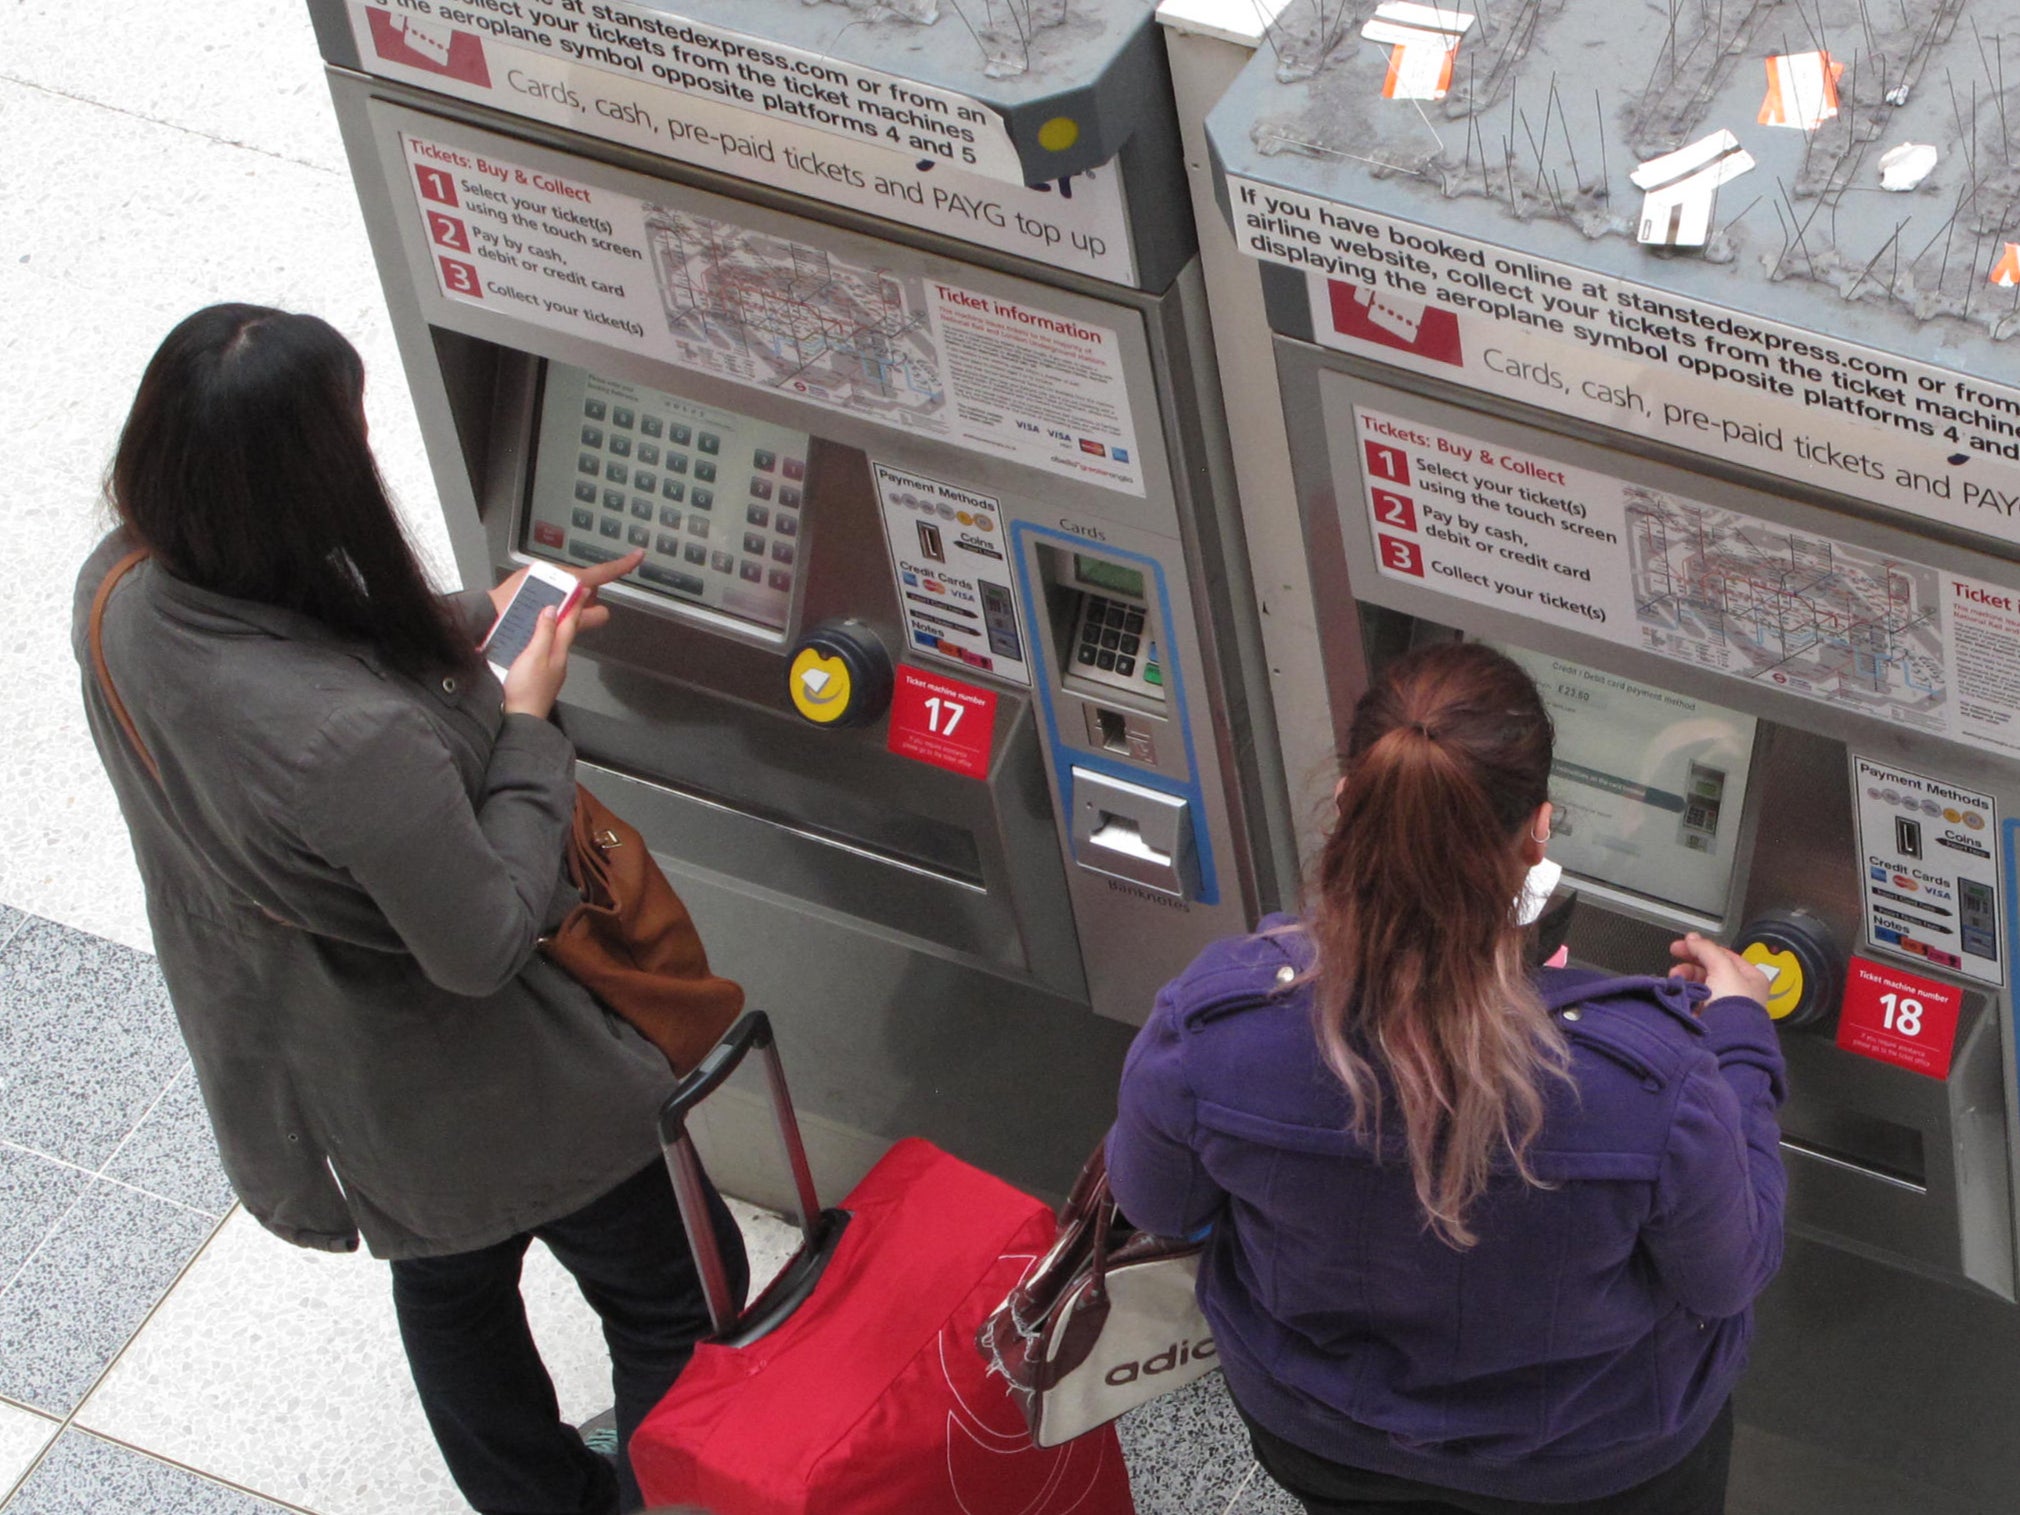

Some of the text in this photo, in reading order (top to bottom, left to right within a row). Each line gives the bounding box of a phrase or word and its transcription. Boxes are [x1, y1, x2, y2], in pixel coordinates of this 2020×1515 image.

[439, 5, 553, 47] aeroplane
[559, 38, 644, 73] symbol
[651, 63, 755, 103] opposite
[762, 93, 879, 137] platforms
[885, 125, 901, 144] 4
[908, 135, 954, 159] and
[961, 145, 977, 165] 5
[528, 9, 580, 34] your
[586, 21, 666, 58] tickets
[671, 44, 730, 76] from
[736, 62, 776, 88] the
[782, 75, 851, 109] ticket
[857, 99, 975, 143] machines
[561, 0, 987, 126] at stanstedexpress.com or from an
[408, 138, 592, 204] Tickets: Buy & Collect
[429, 173, 444, 199] 1
[507, 69, 1107, 260] Cards, cash, pre-paid tickets and PAYG top up
[460, 178, 613, 237] Select your ticket(s)
[438, 218, 460, 246] 2
[465, 200, 643, 261] using the touch screen
[471, 225, 568, 266] Pay by cash,
[450, 264, 470, 291] 3
[477, 244, 626, 298] debit or credit card
[486, 280, 645, 339] Collect your ticket(s)
[934, 284, 990, 313] Ticket
[993, 300, 1102, 345] information
[1240, 185, 2020, 417] If you have booked online at stanstedexpress.com or from
[1246, 212, 1322, 245] airline
[1329, 235, 1438, 280] website,
[1446, 268, 1534, 304] collect
[1541, 293, 1600, 320] your
[1607, 308, 1697, 348] tickets
[1704, 335, 1770, 369] from
[1777, 355, 1823, 383] the
[1830, 370, 1907, 407] ticket
[1250, 234, 2020, 461] displaying the aeroplane symbol opposite platforms 4 and
[1360, 414, 1566, 487] Tickets: Buy & Collect
[1483, 348, 2020, 517] Cards, cash, pre-paid tickets and PAY
[1377, 450, 1396, 477] 1
[879, 469, 995, 512] Payment Methods
[1383, 496, 1406, 525] 2
[1415, 457, 1587, 520] Select your ticket(s)
[1059, 518, 1106, 541] Cards
[1419, 479, 1617, 545] using the touch screen
[1422, 504, 1529, 548] Pay by cash,
[960, 532, 994, 549] Coins
[1391, 541, 1412, 569] 3
[1425, 523, 1591, 582] debit or credit card
[900, 560, 973, 590] Credit Cards
[1430, 560, 1607, 624] Collect your ticket(s)
[1952, 581, 2011, 611] Ticket
[911, 620, 944, 637] Notes
[924, 697, 965, 736] 17
[1860, 763, 1989, 810] Payment Methods
[1945, 830, 1982, 848] Coins
[1869, 856, 1951, 888] Credit Cards
[1924, 886, 1951, 900] VISA
[1108, 879, 1190, 914] Banknotes
[1873, 915, 1910, 934] Notes
[1859, 970, 1949, 1003] Ticket machine number
[1879, 993, 1924, 1037] 18
